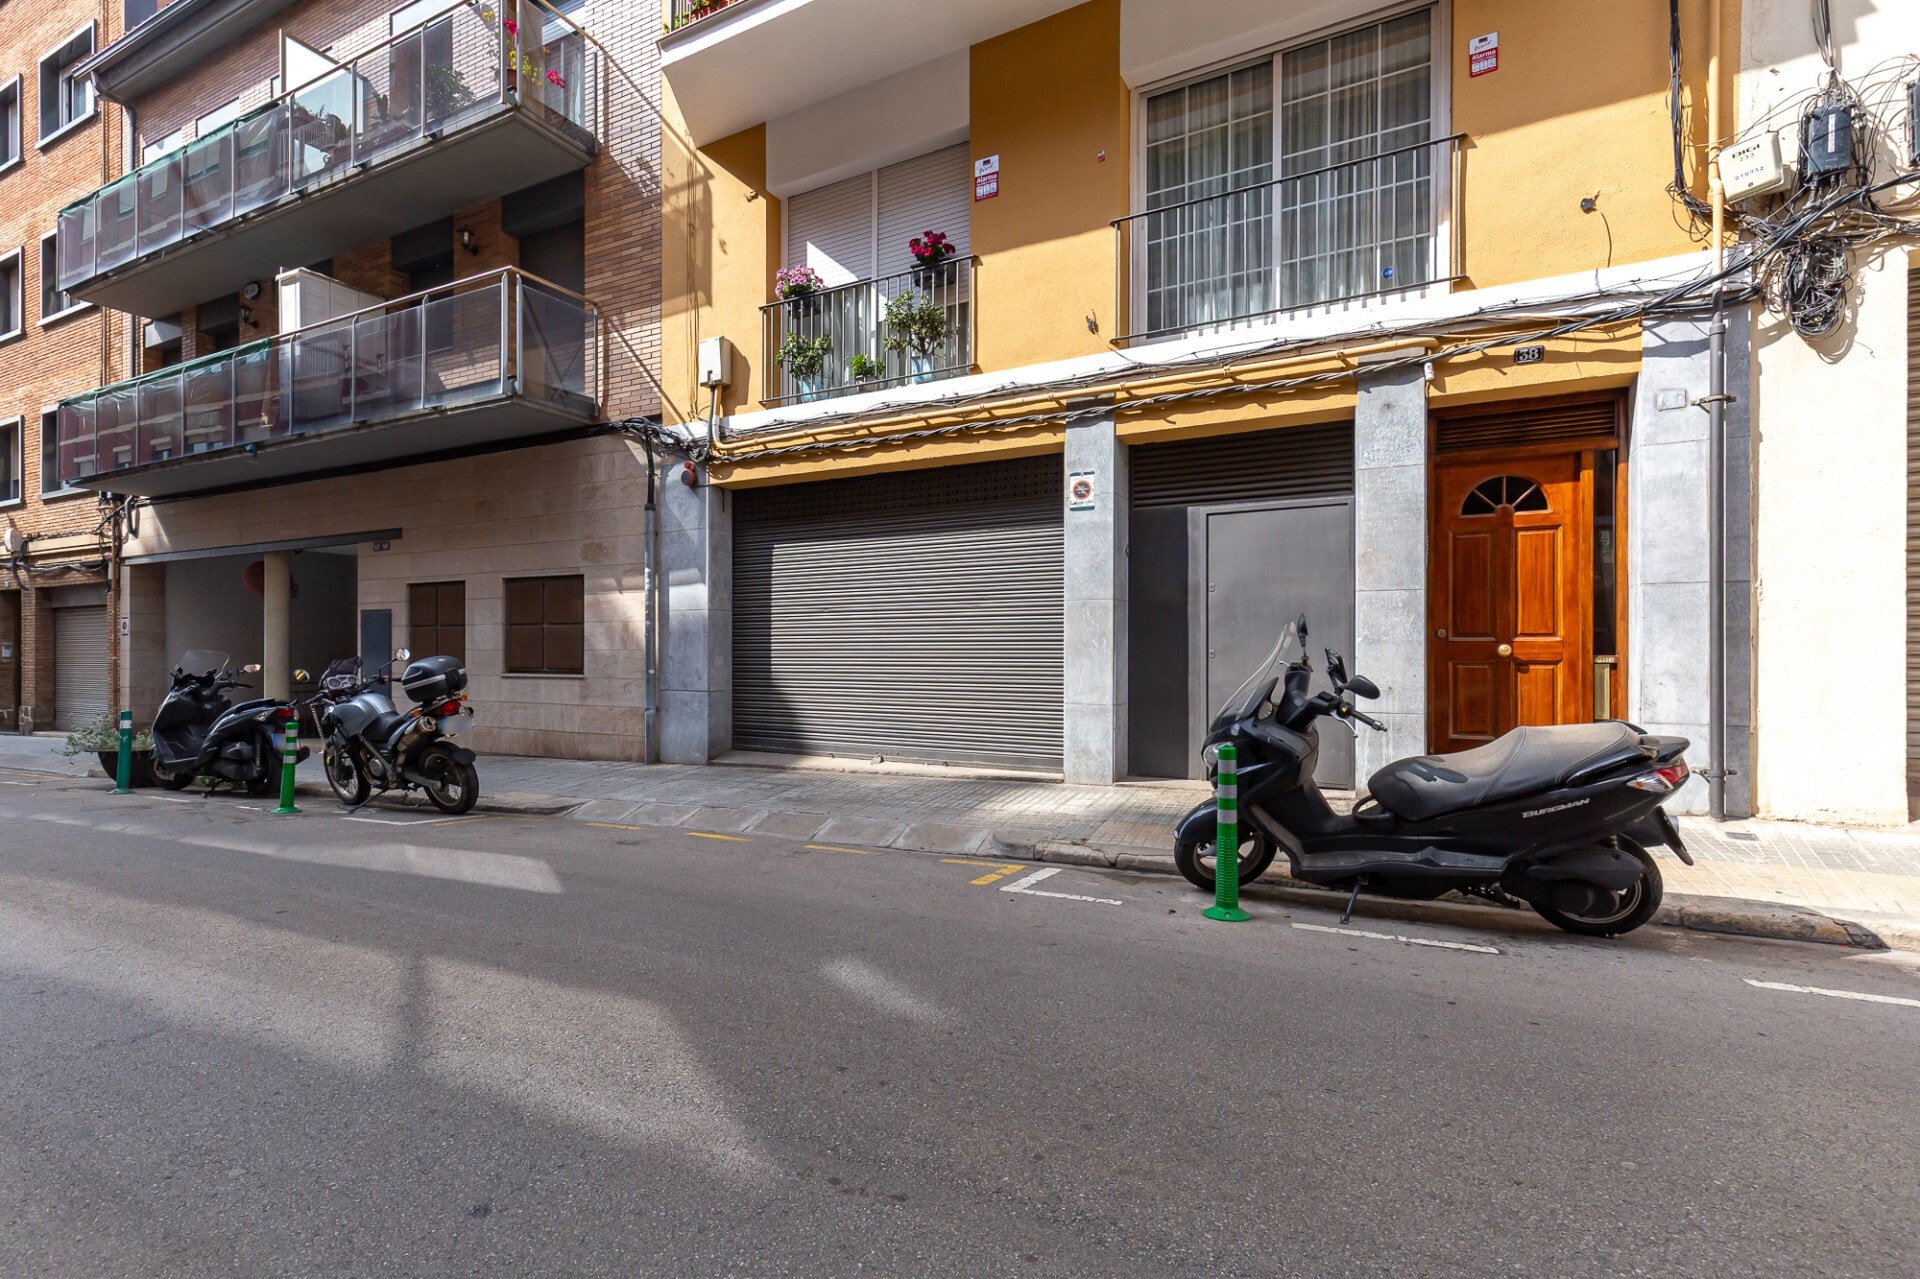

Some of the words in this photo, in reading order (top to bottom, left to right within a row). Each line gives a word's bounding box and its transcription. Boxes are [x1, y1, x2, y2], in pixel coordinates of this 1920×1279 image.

[1472, 49, 1497, 61] Alarma
[1732, 143, 1760, 159] DIGI
[976, 173, 998, 184] Alarma
[1519, 347, 1539, 361] 38
[1522, 797, 1591, 818] BURGMAN
